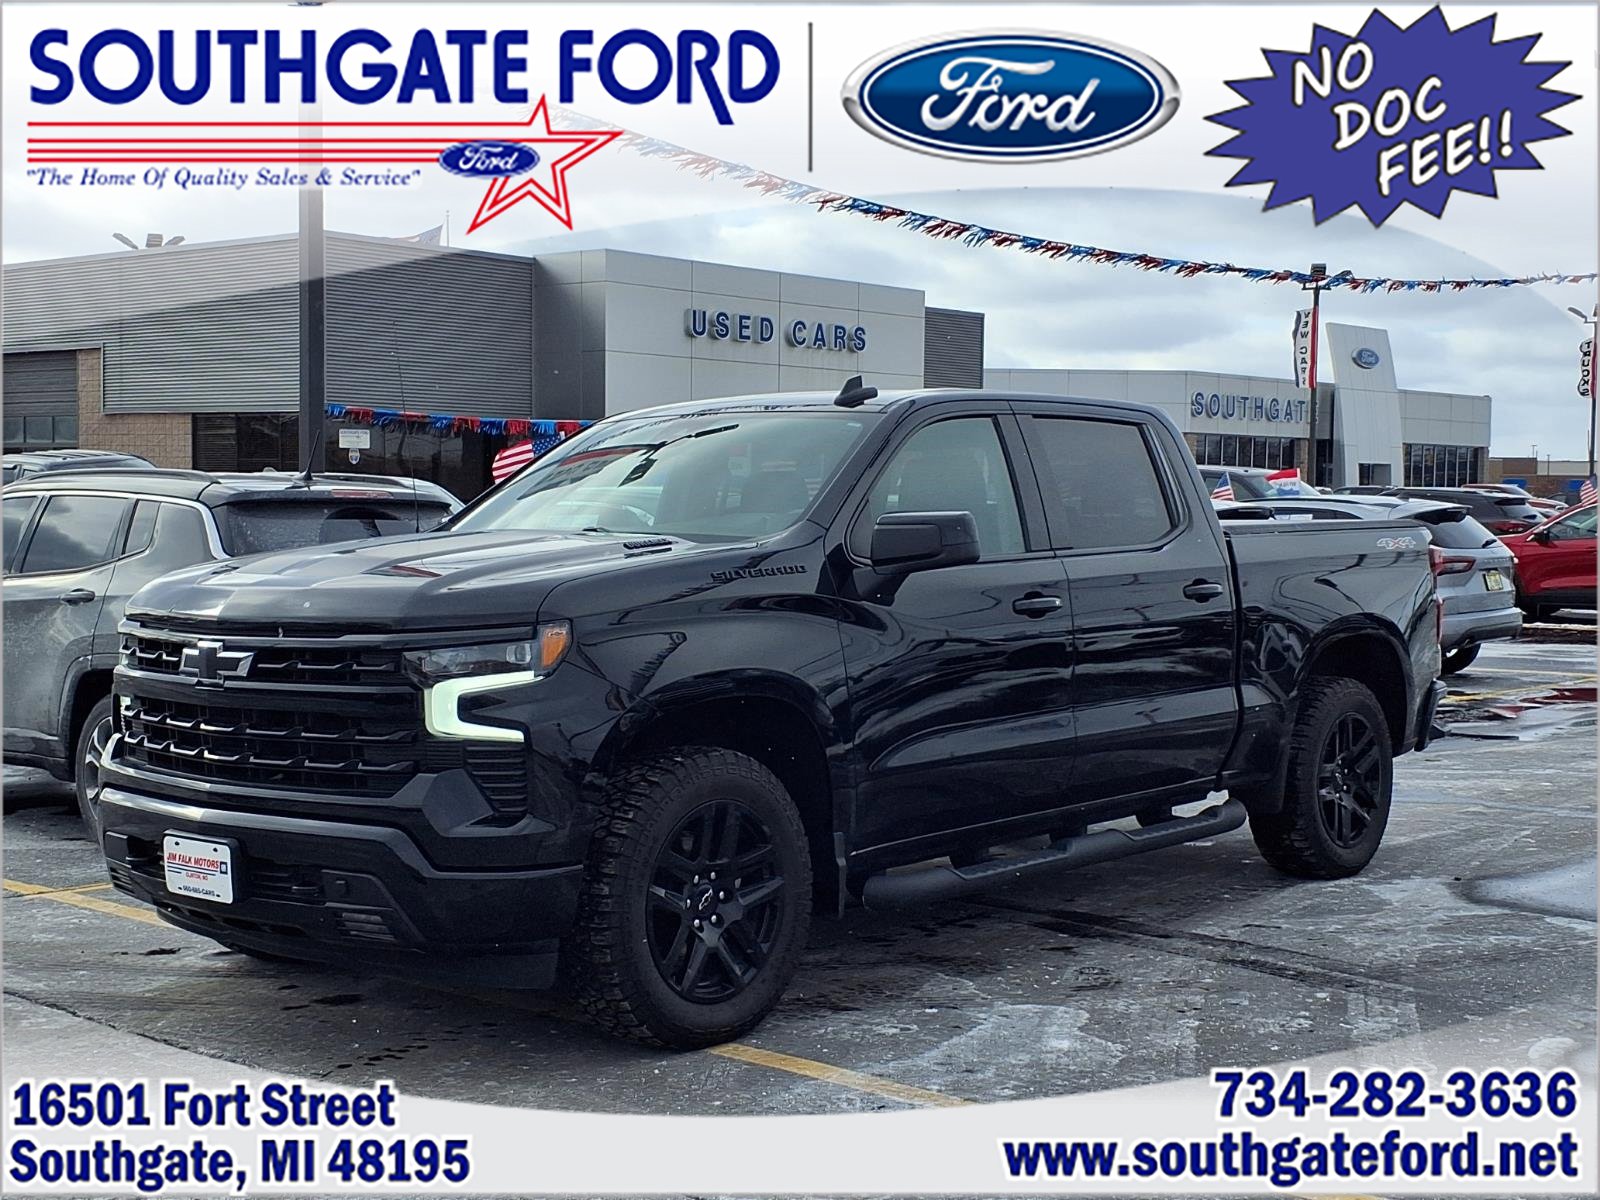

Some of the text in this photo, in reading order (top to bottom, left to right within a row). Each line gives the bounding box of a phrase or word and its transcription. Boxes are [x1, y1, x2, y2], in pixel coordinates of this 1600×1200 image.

[686, 308, 867, 352] USED CARS
[1192, 391, 1310, 424] SOUTHGAT
[710, 565, 808, 581] SILVERADO
[167, 852, 219, 869] JIM FALK MOTORS
